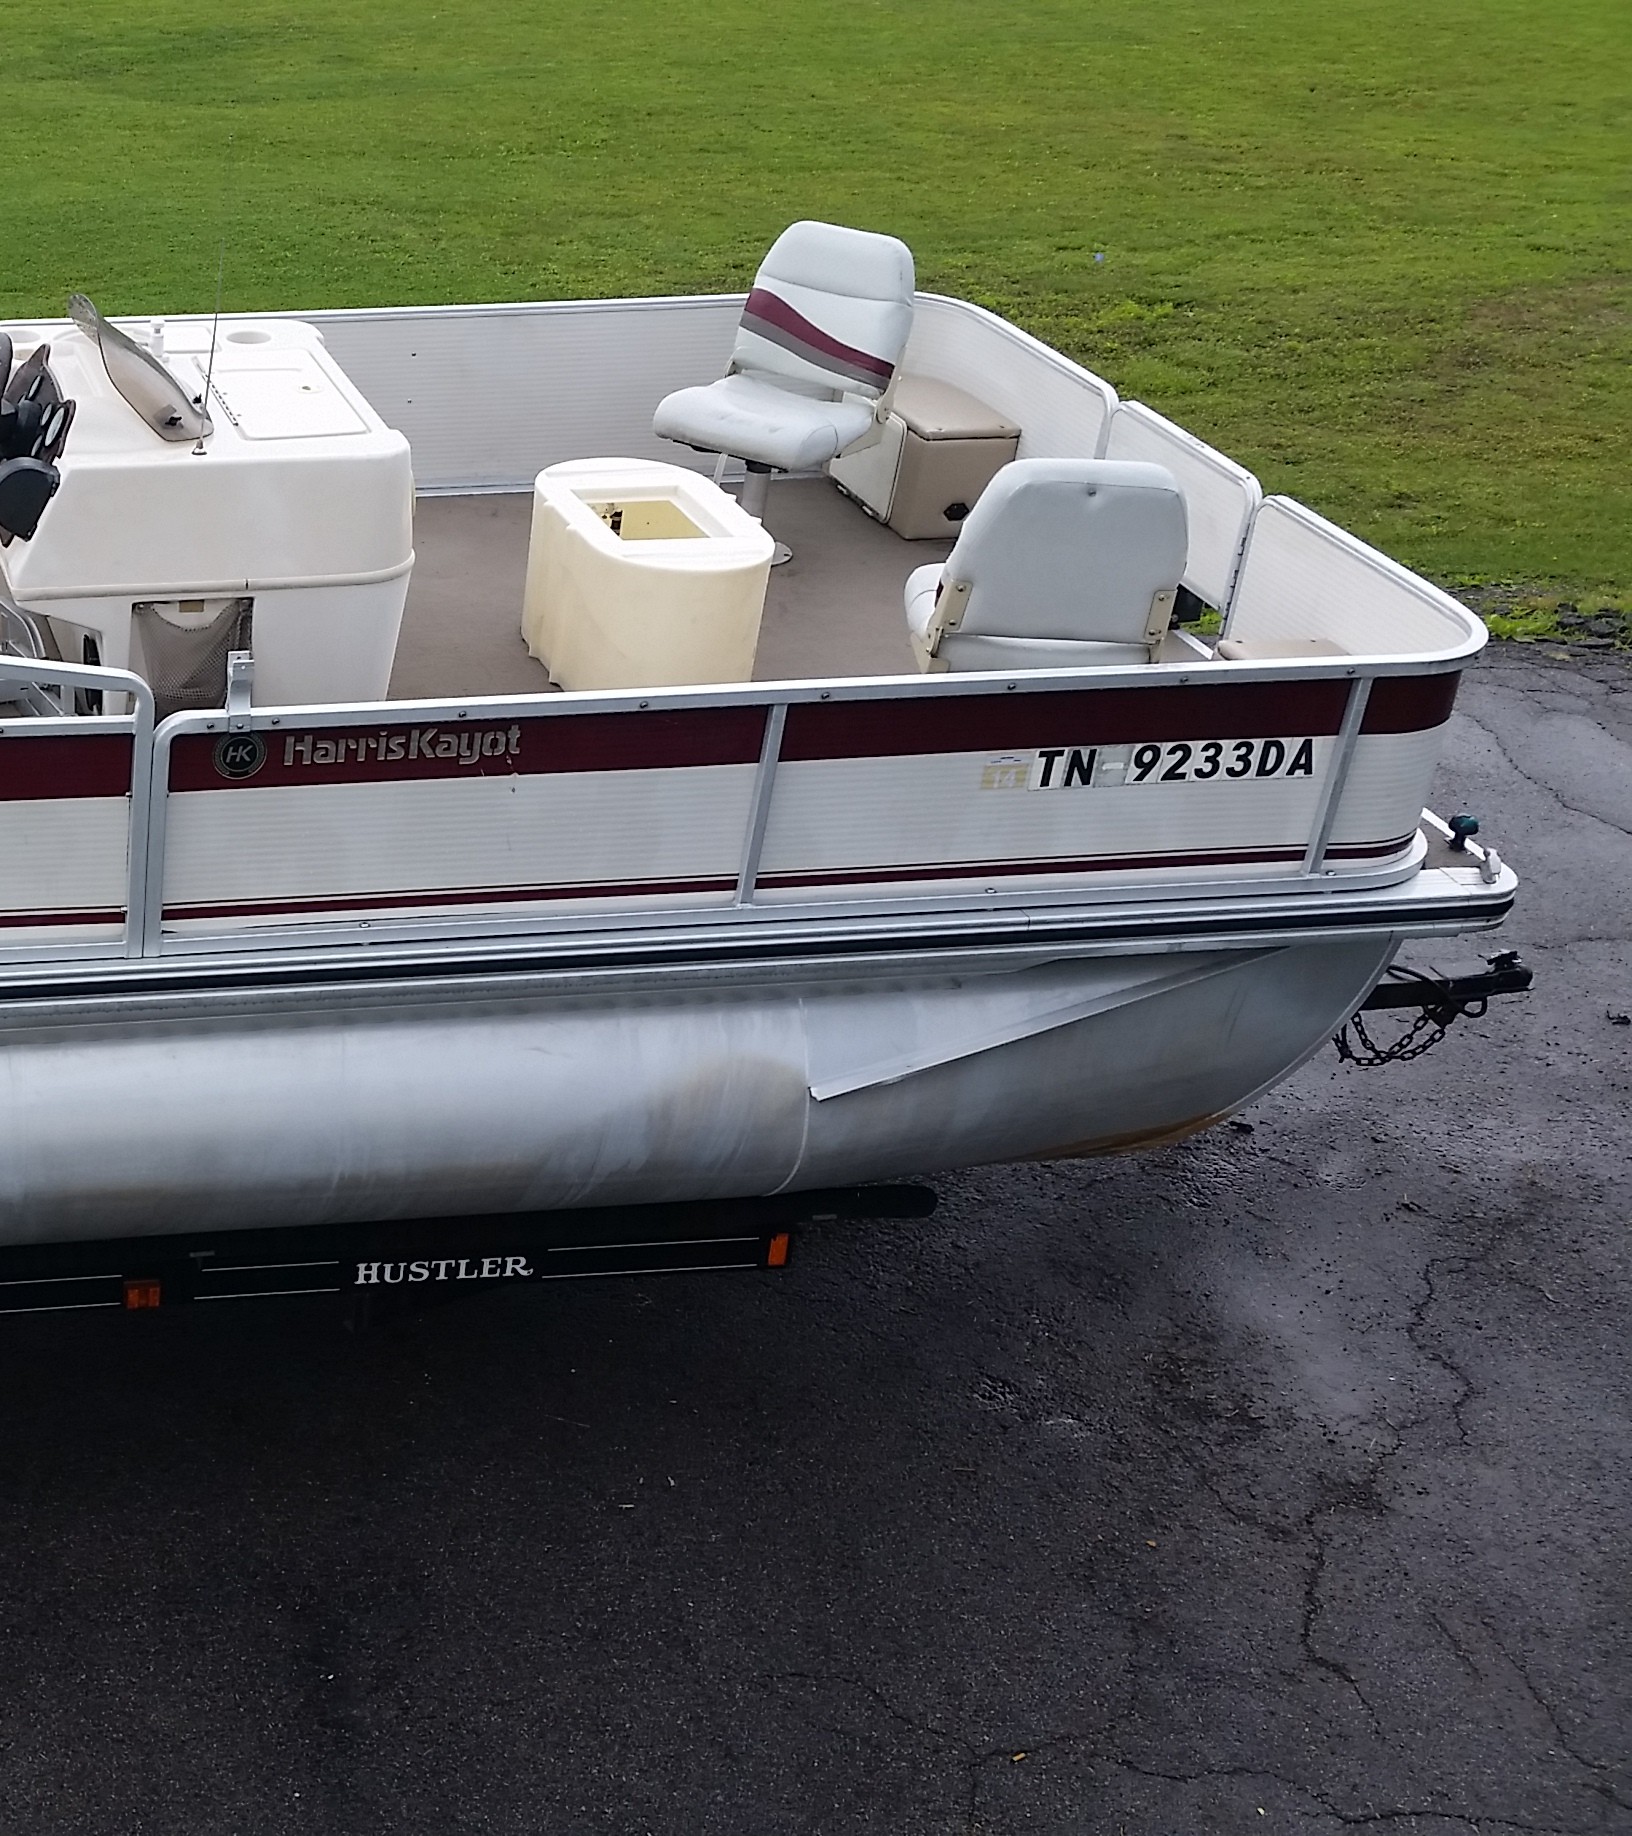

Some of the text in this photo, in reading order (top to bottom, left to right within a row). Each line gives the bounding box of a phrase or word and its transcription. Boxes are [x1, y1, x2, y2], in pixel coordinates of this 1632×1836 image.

[225, 744, 253, 763] HK
[283, 724, 521, 766] HarrisKayot
[1037, 738, 1314, 788] TN 9233DA
[354, 1256, 534, 1284] HUSTLER
